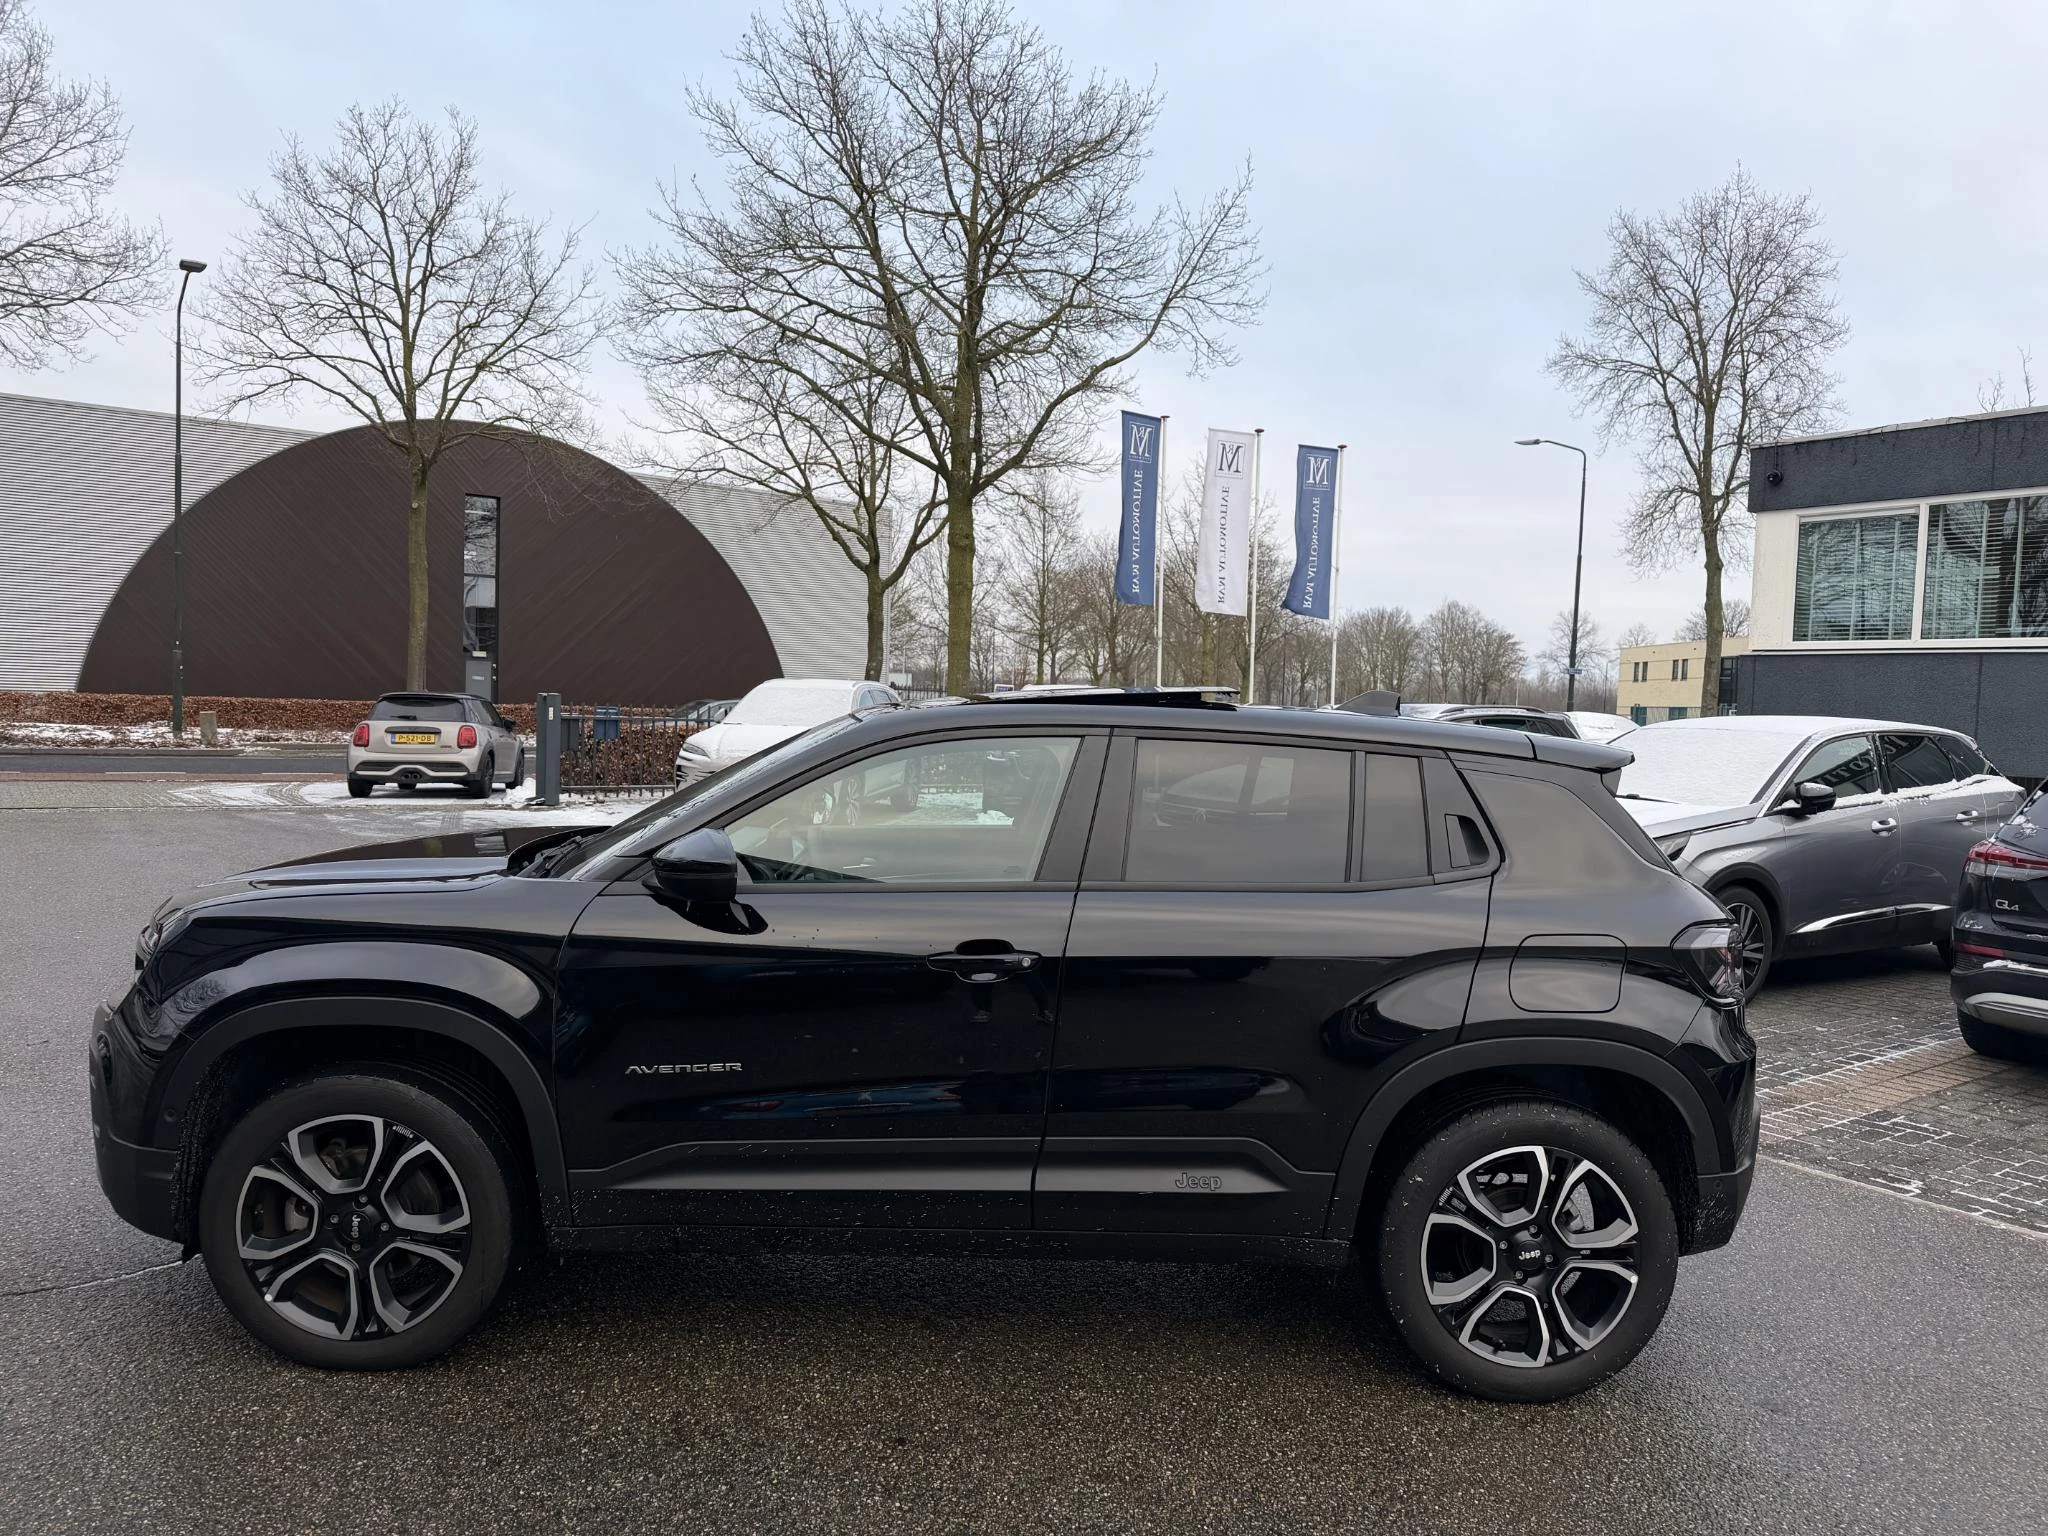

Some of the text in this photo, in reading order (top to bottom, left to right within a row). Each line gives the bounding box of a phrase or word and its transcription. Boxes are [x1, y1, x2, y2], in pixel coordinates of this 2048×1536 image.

[1994, 899, 2019, 912] Q4
[625, 1062, 743, 1074] AVENGER
[1174, 1171, 1223, 1192] Jeep
[350, 1214, 361, 1238] Jeep
[1518, 1249, 1541, 1262] Jeep
